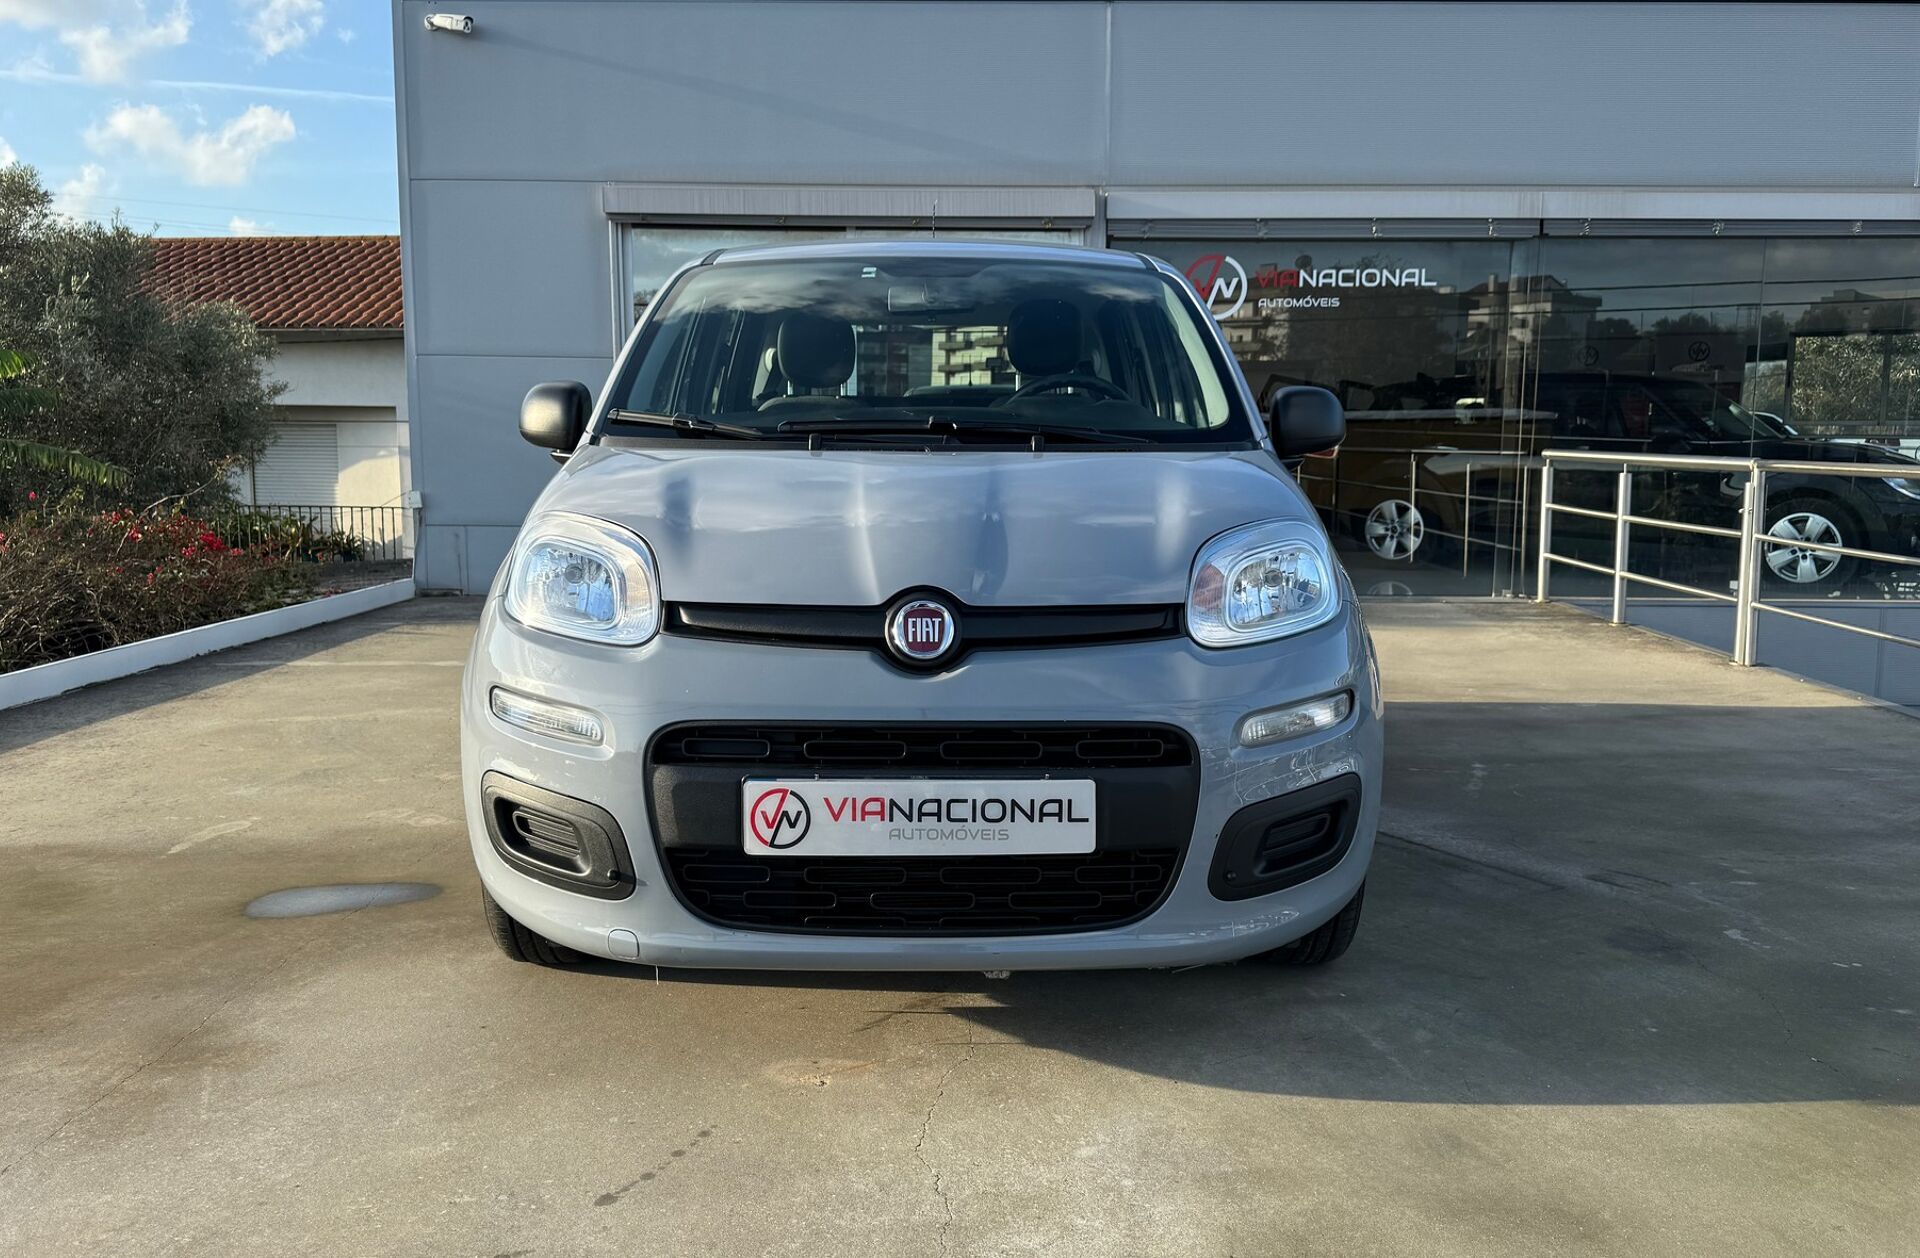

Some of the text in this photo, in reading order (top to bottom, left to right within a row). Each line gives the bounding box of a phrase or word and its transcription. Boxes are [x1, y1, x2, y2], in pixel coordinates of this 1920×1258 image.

[1255, 268, 1438, 289] VIANACIONAL
[1258, 295, 1341, 309] AUTOMÓVEIS
[907, 617, 942, 643] FIAT
[823, 797, 1090, 823] VIANACIONAL
[888, 825, 1010, 841] AUTOMÓVEIS
